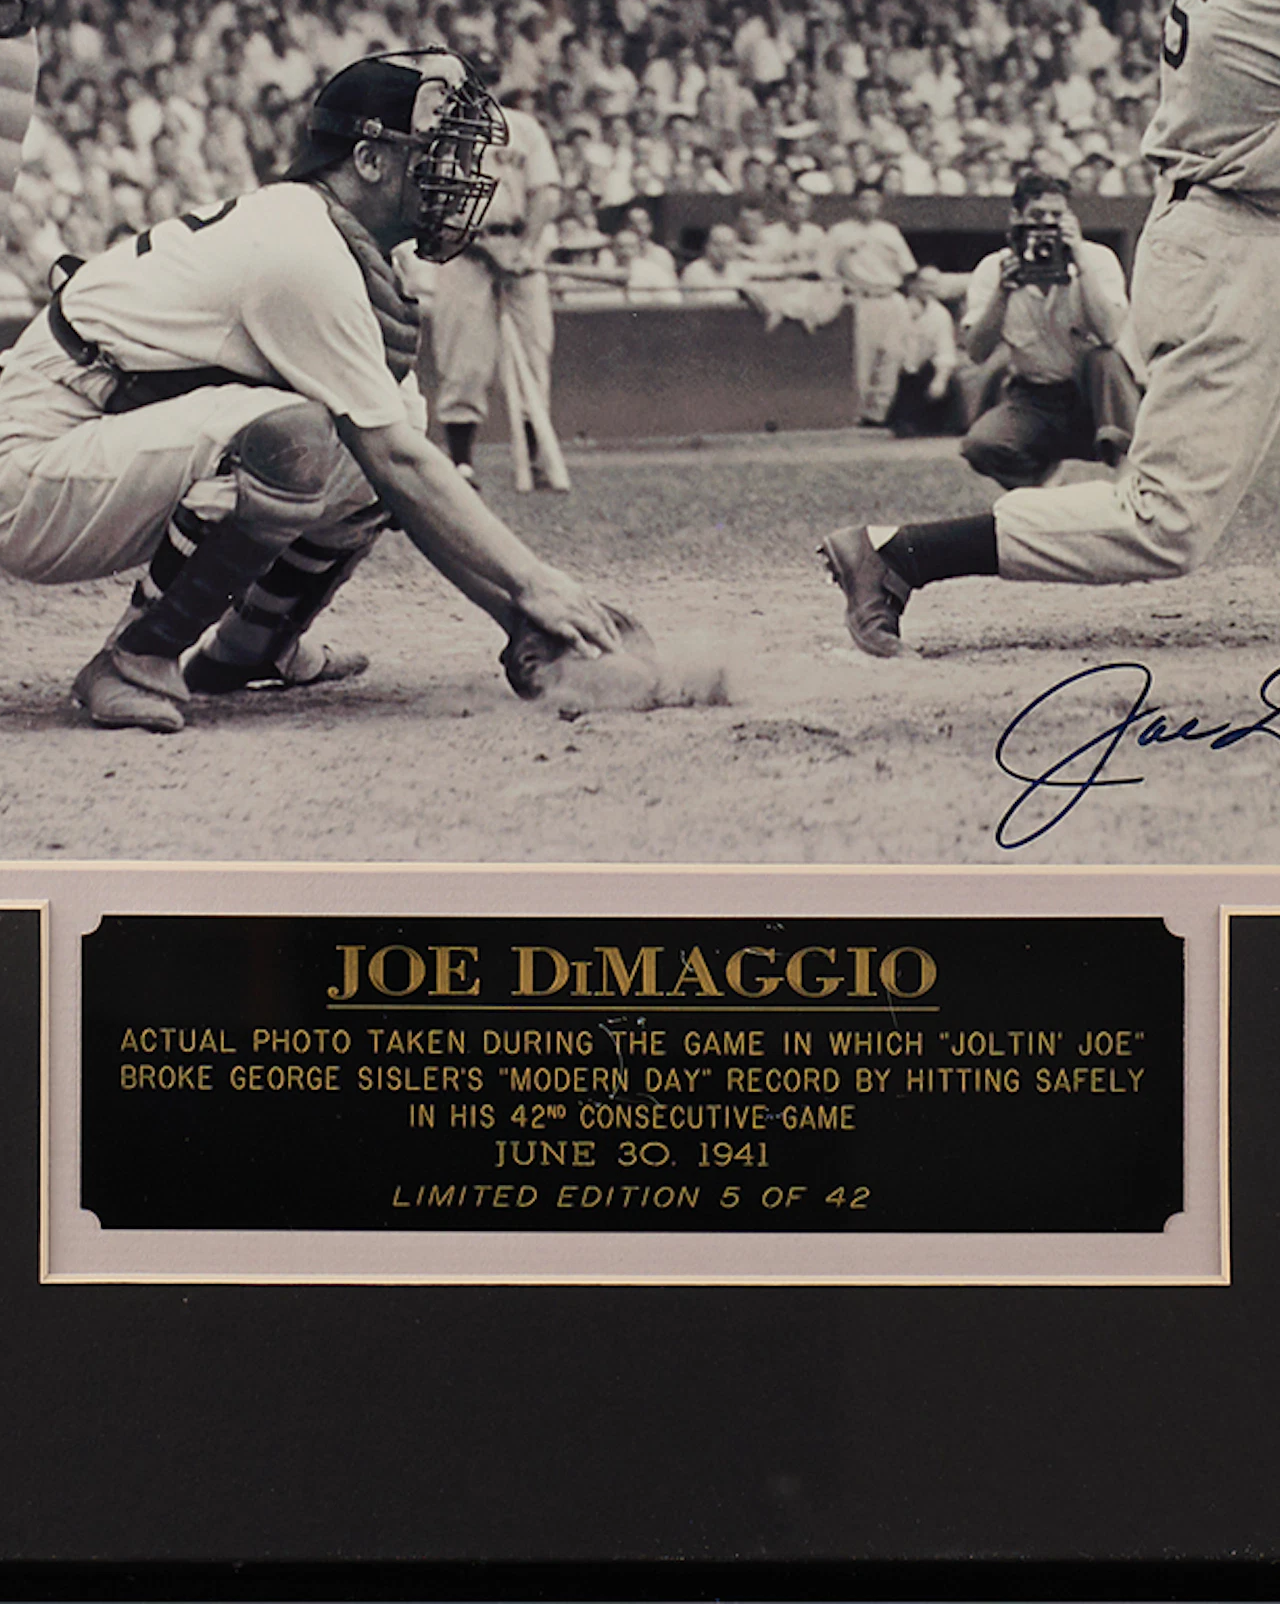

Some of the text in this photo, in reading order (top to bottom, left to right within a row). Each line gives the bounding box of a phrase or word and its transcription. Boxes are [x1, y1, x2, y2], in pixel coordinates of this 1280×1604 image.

[995, 662, 1226, 850] Joe
[326, 944, 481, 1001] JOE
[120, 1028, 1145, 1057] ACTUAL PHOTO TAKEN DURING THE GAME IN WHICH "JOLTIN' JOE"
[120, 1064, 1145, 1094] BROKE GEORGE SISLER'S "MODERN DAY" RECORD BY HITTING SAFELY
[409, 1103, 435, 1129] IN
[450, 1103, 496, 1129] HIS
[579, 1103, 767, 1130] CONSECUTIVE
[781, 1105, 856, 1131] GAME
[496, 1140, 596, 1168] JUNE
[698, 1141, 768, 1168] 1941
[392, 1185, 871, 1209] LIMITED EDITION 5 OF 42
